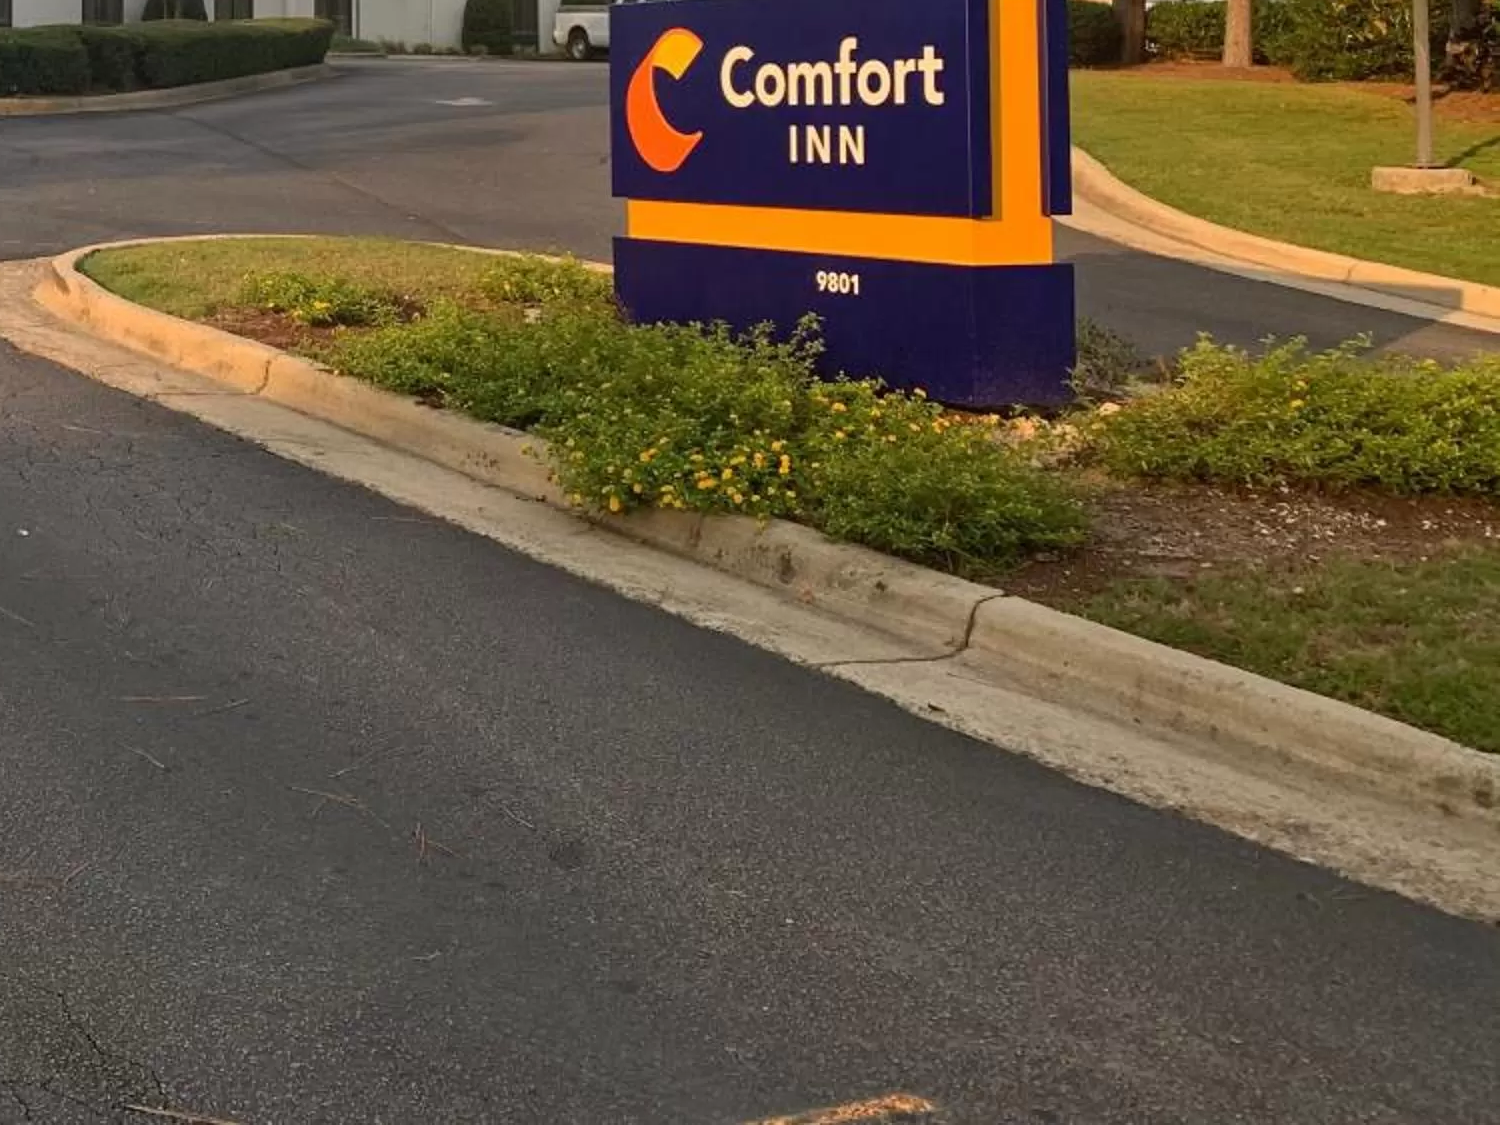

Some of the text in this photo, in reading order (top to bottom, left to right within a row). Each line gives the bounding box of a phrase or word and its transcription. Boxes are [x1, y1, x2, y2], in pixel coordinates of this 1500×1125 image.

[720, 36, 945, 107] Comfort
[788, 125, 866, 165] INN
[816, 271, 860, 296] 9801
